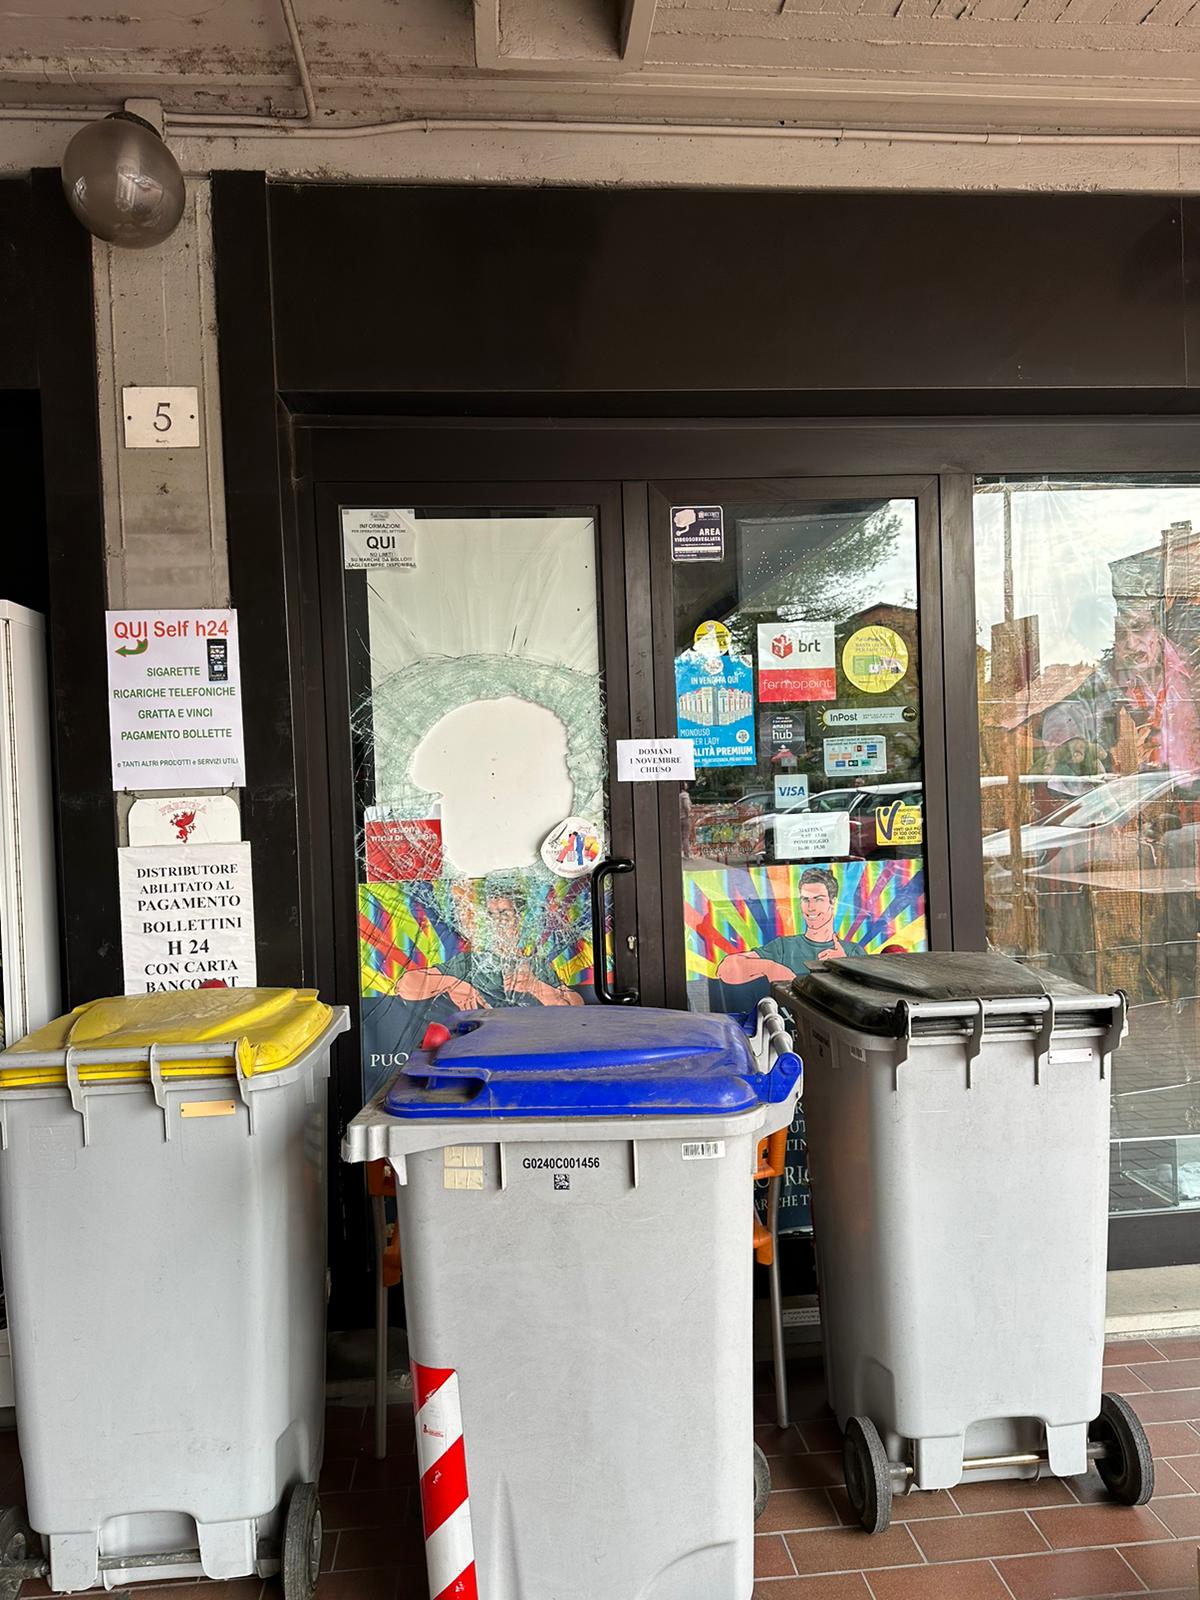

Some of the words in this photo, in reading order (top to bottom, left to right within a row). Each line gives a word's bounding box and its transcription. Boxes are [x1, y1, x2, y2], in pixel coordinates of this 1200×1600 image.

[153, 402, 172, 432] 5
[699, 528, 720, 536] AREA
[366, 536, 396, 550] QUI
[114, 621, 148, 640] QUI
[153, 620, 190, 638] Self
[195, 620, 229, 637] h24
[798, 639, 821, 653] brt
[146, 666, 200, 677] SIGARETTE
[763, 679, 832, 691] fermopoint
[113, 688, 166, 699] RICARICHE
[168, 687, 236, 698] TELEFONICHE
[138, 709, 176, 720] GRATTA
[177, 708, 185, 718] E
[186, 708, 213, 718] VINCI
[830, 713, 858, 721] InPost
[121, 731, 180, 741] PAGAMENTO
[182, 729, 232, 739] BOLLETTE
[772, 729, 793, 740] hub
[716, 746, 753, 756] PREMIUM
[197, 758, 222, 766] SERVIZI
[222, 757, 239, 765] UTILI
[778, 786, 805, 797] VISA
[137, 863, 238, 879] DISTRIBUTORE
[140, 881, 213, 895] ABILITATO
[215, 880, 235, 891] AL
[137, 895, 241, 912] PAGAMENTO
[142, 917, 242, 934] BOLLETTINI
[168, 940, 182, 955] H
[189, 938, 210, 954] 24
[144, 963, 179, 976] CON
[184, 959, 238, 974] CARTA
[146, 975, 239, 993] BANCOT
[522, 1157, 600, 1169] G0240C001456
